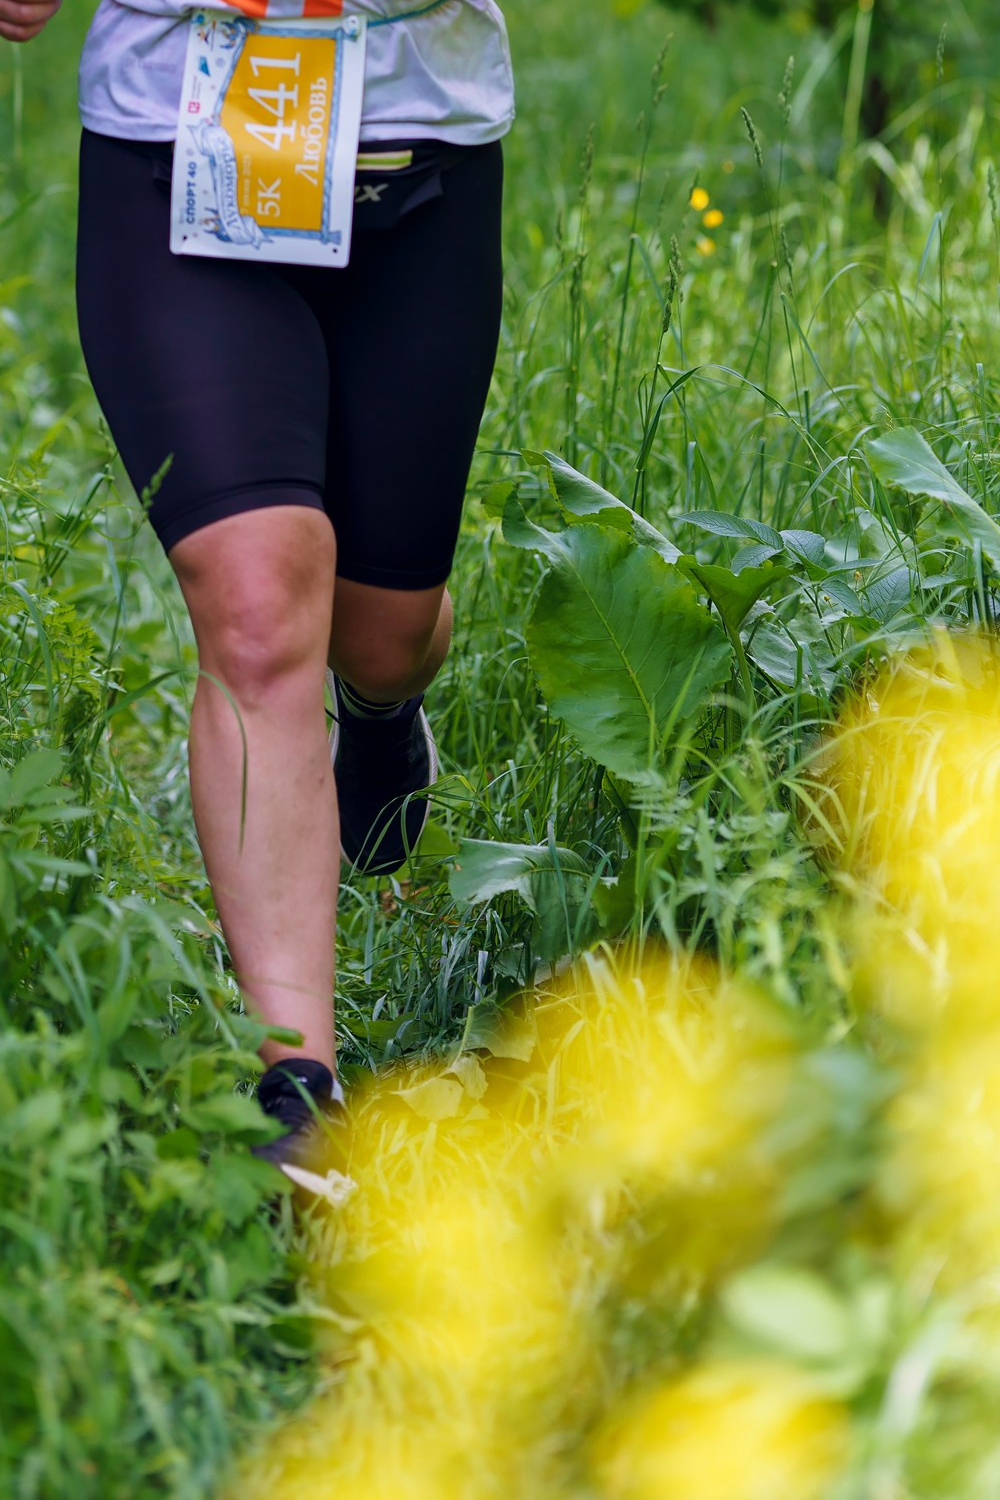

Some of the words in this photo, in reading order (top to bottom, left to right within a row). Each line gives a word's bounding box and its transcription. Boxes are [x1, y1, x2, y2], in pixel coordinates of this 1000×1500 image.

[244, 51, 302, 151] 441
[295, 77, 328, 187] Любовь
[185, 179, 197, 224] СПОРТ
[187, 161, 197, 177] 40
